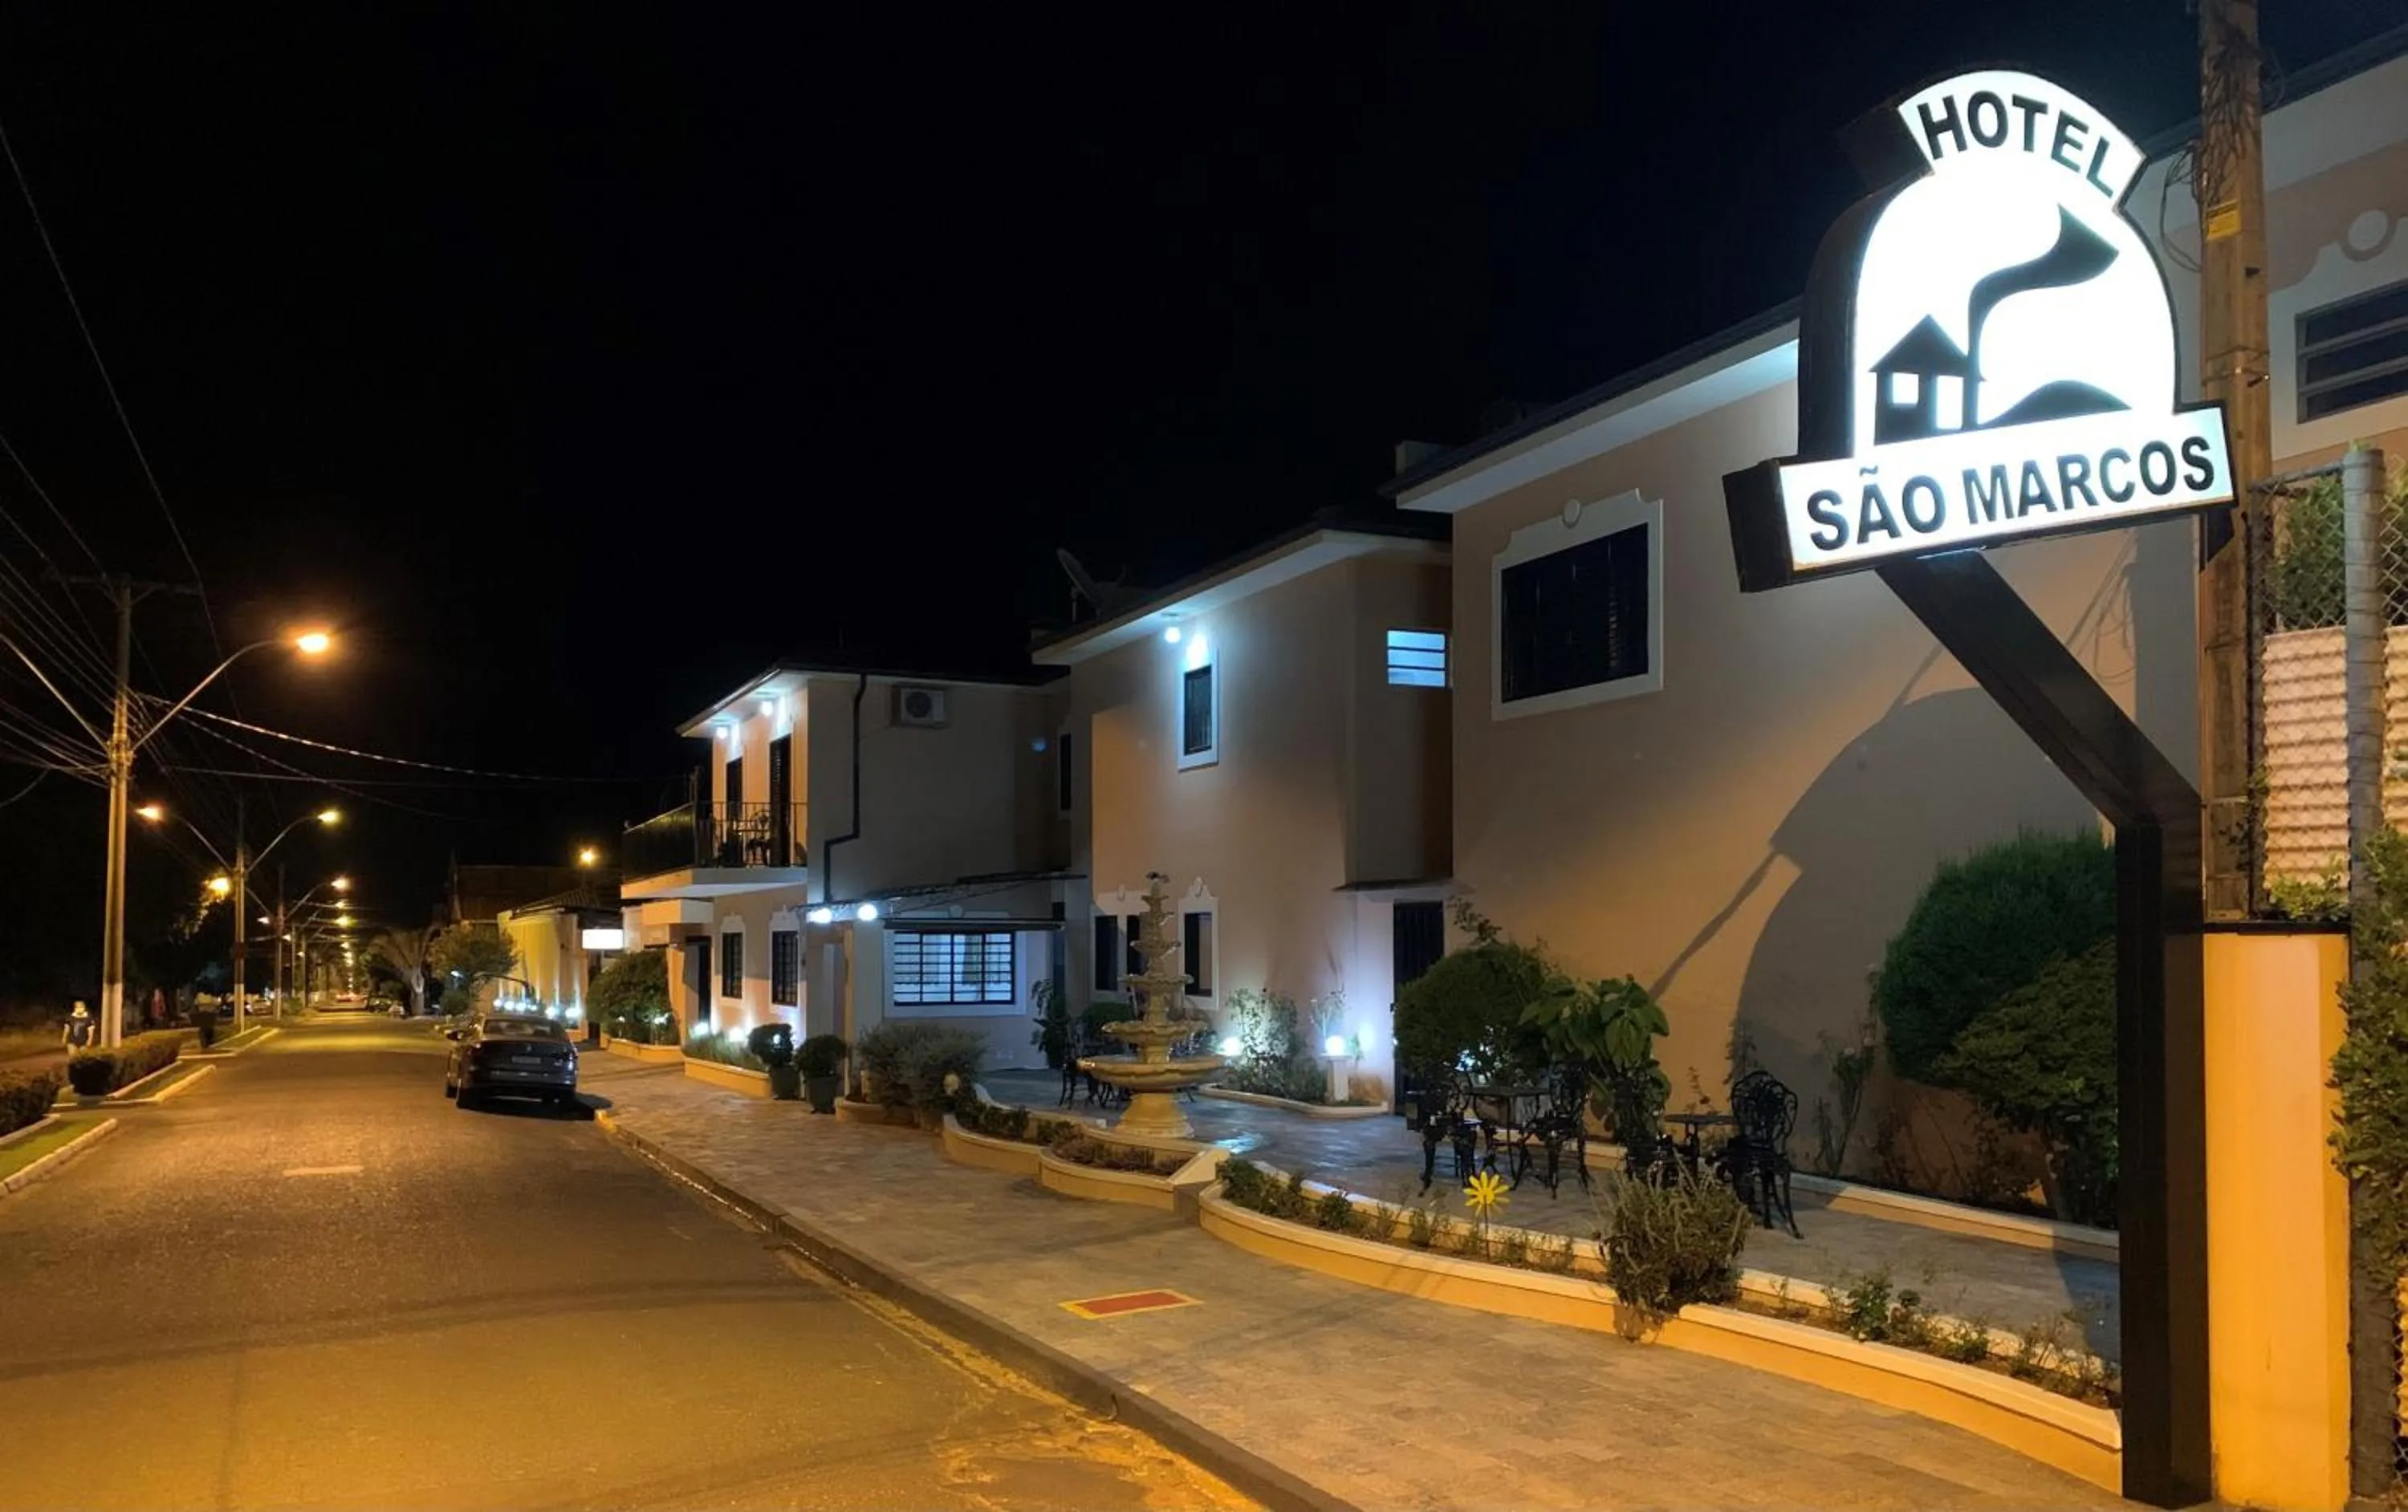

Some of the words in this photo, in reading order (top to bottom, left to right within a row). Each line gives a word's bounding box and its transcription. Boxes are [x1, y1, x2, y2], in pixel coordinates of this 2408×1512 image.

[1916, 90, 2115, 200] HOTEL
[1807, 465, 1945, 551] SÃO
[1962, 436, 2215, 525] MARCOS
